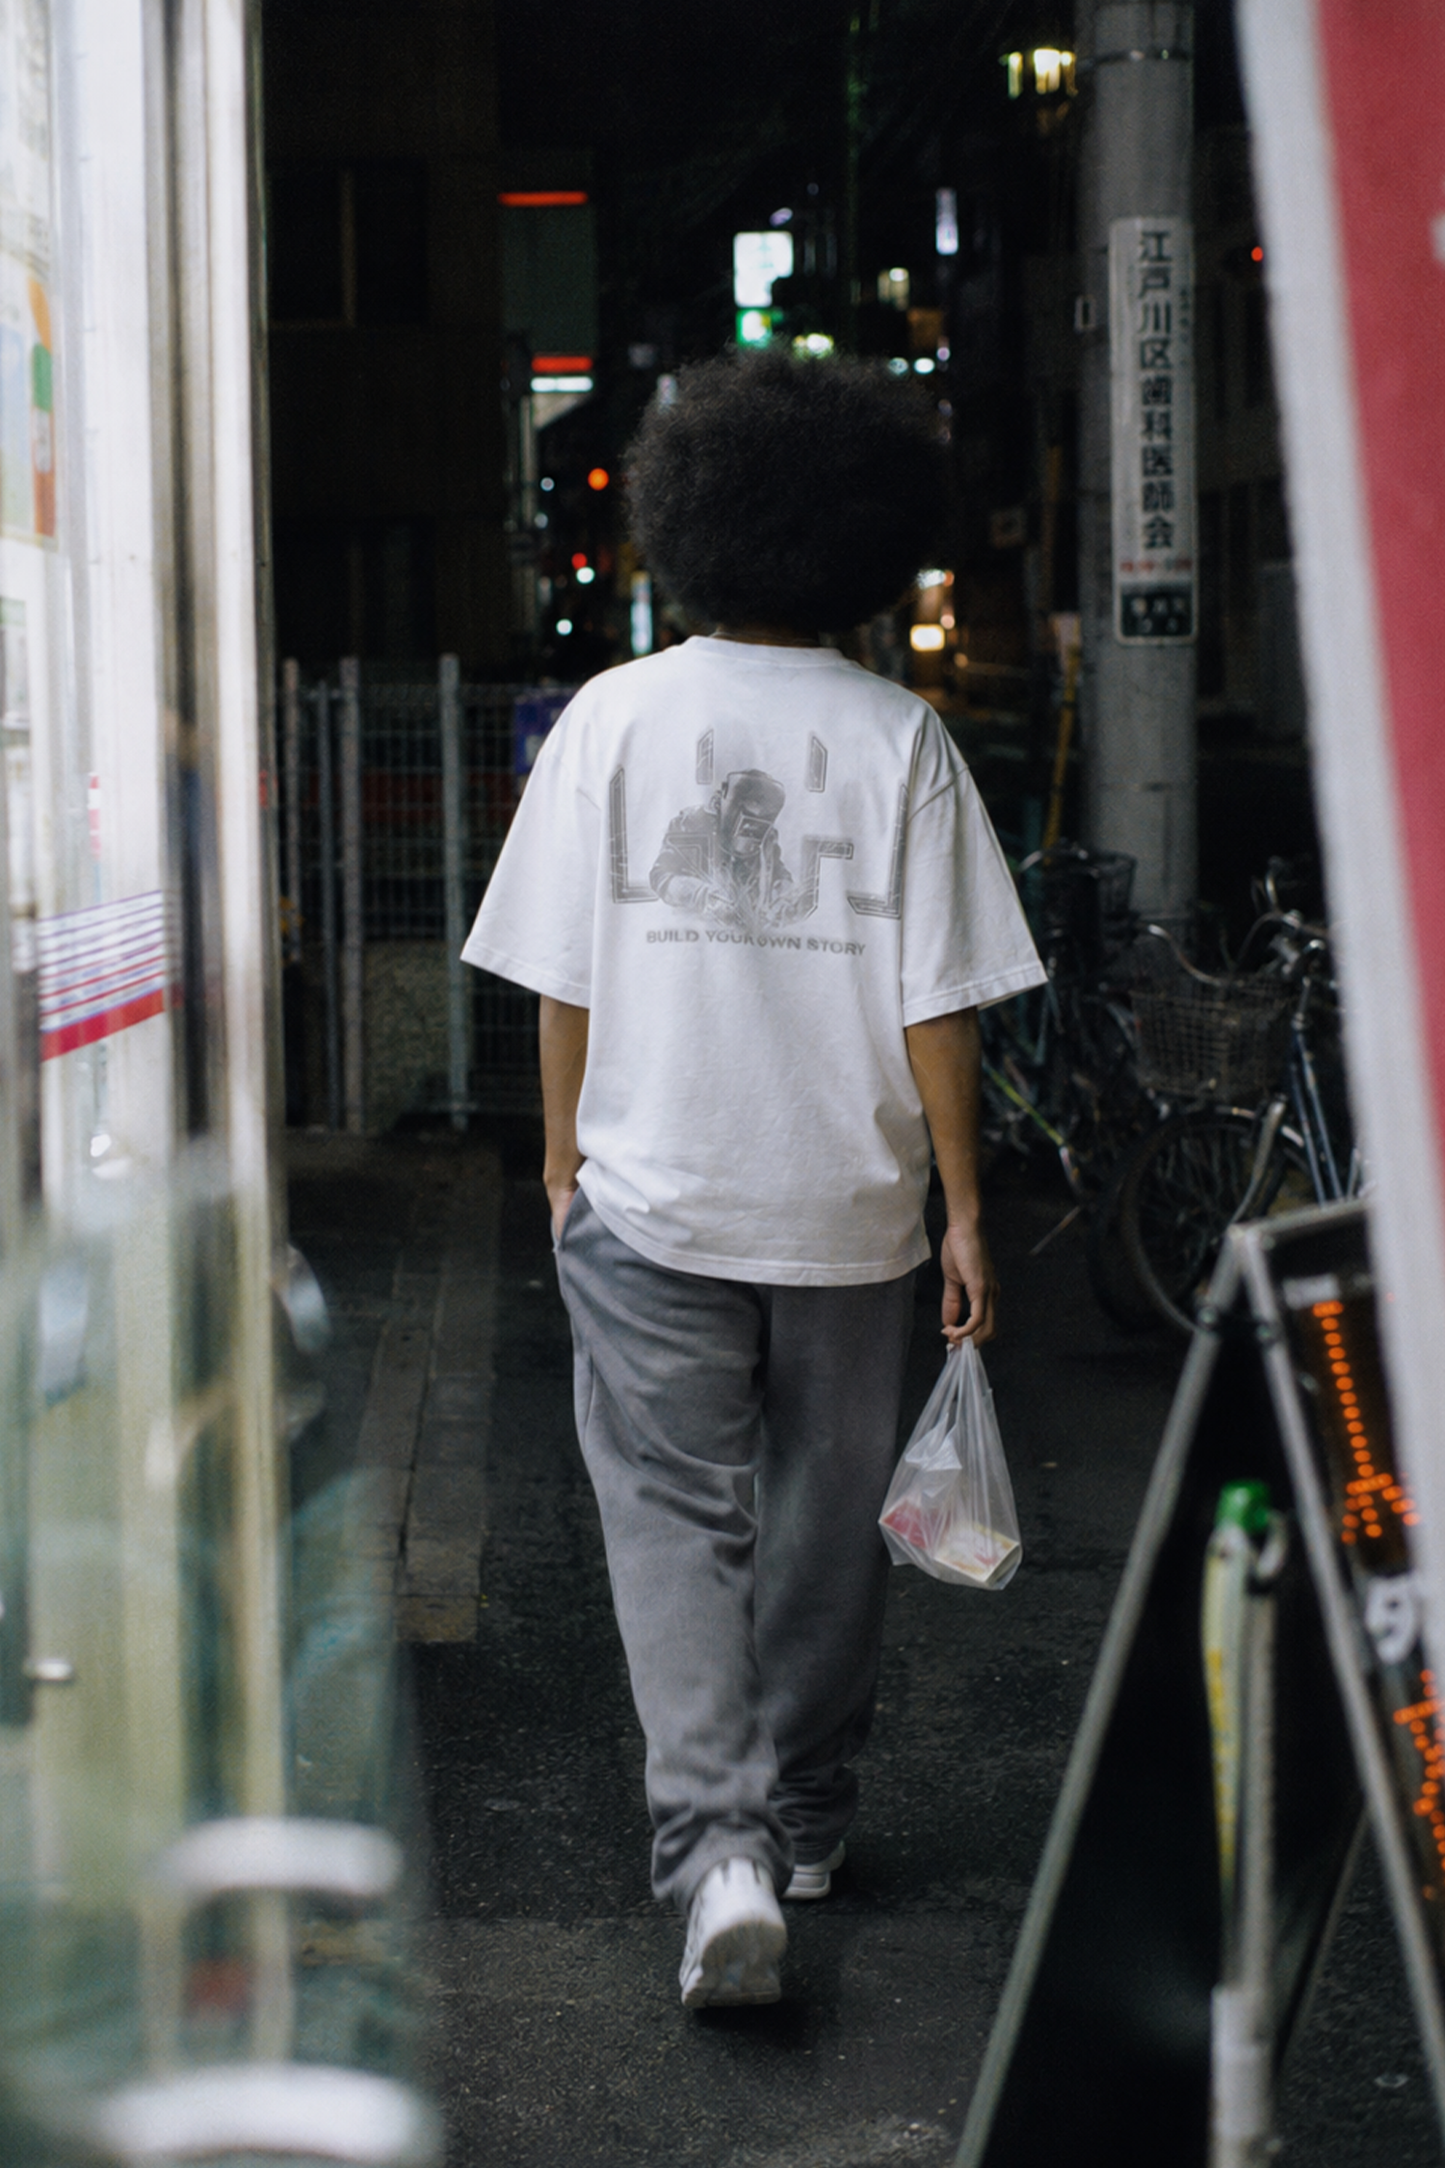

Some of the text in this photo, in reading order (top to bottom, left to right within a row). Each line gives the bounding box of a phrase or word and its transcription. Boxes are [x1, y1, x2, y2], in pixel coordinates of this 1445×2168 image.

[646, 930, 866, 955] BUILD YOUR OWN STORY
